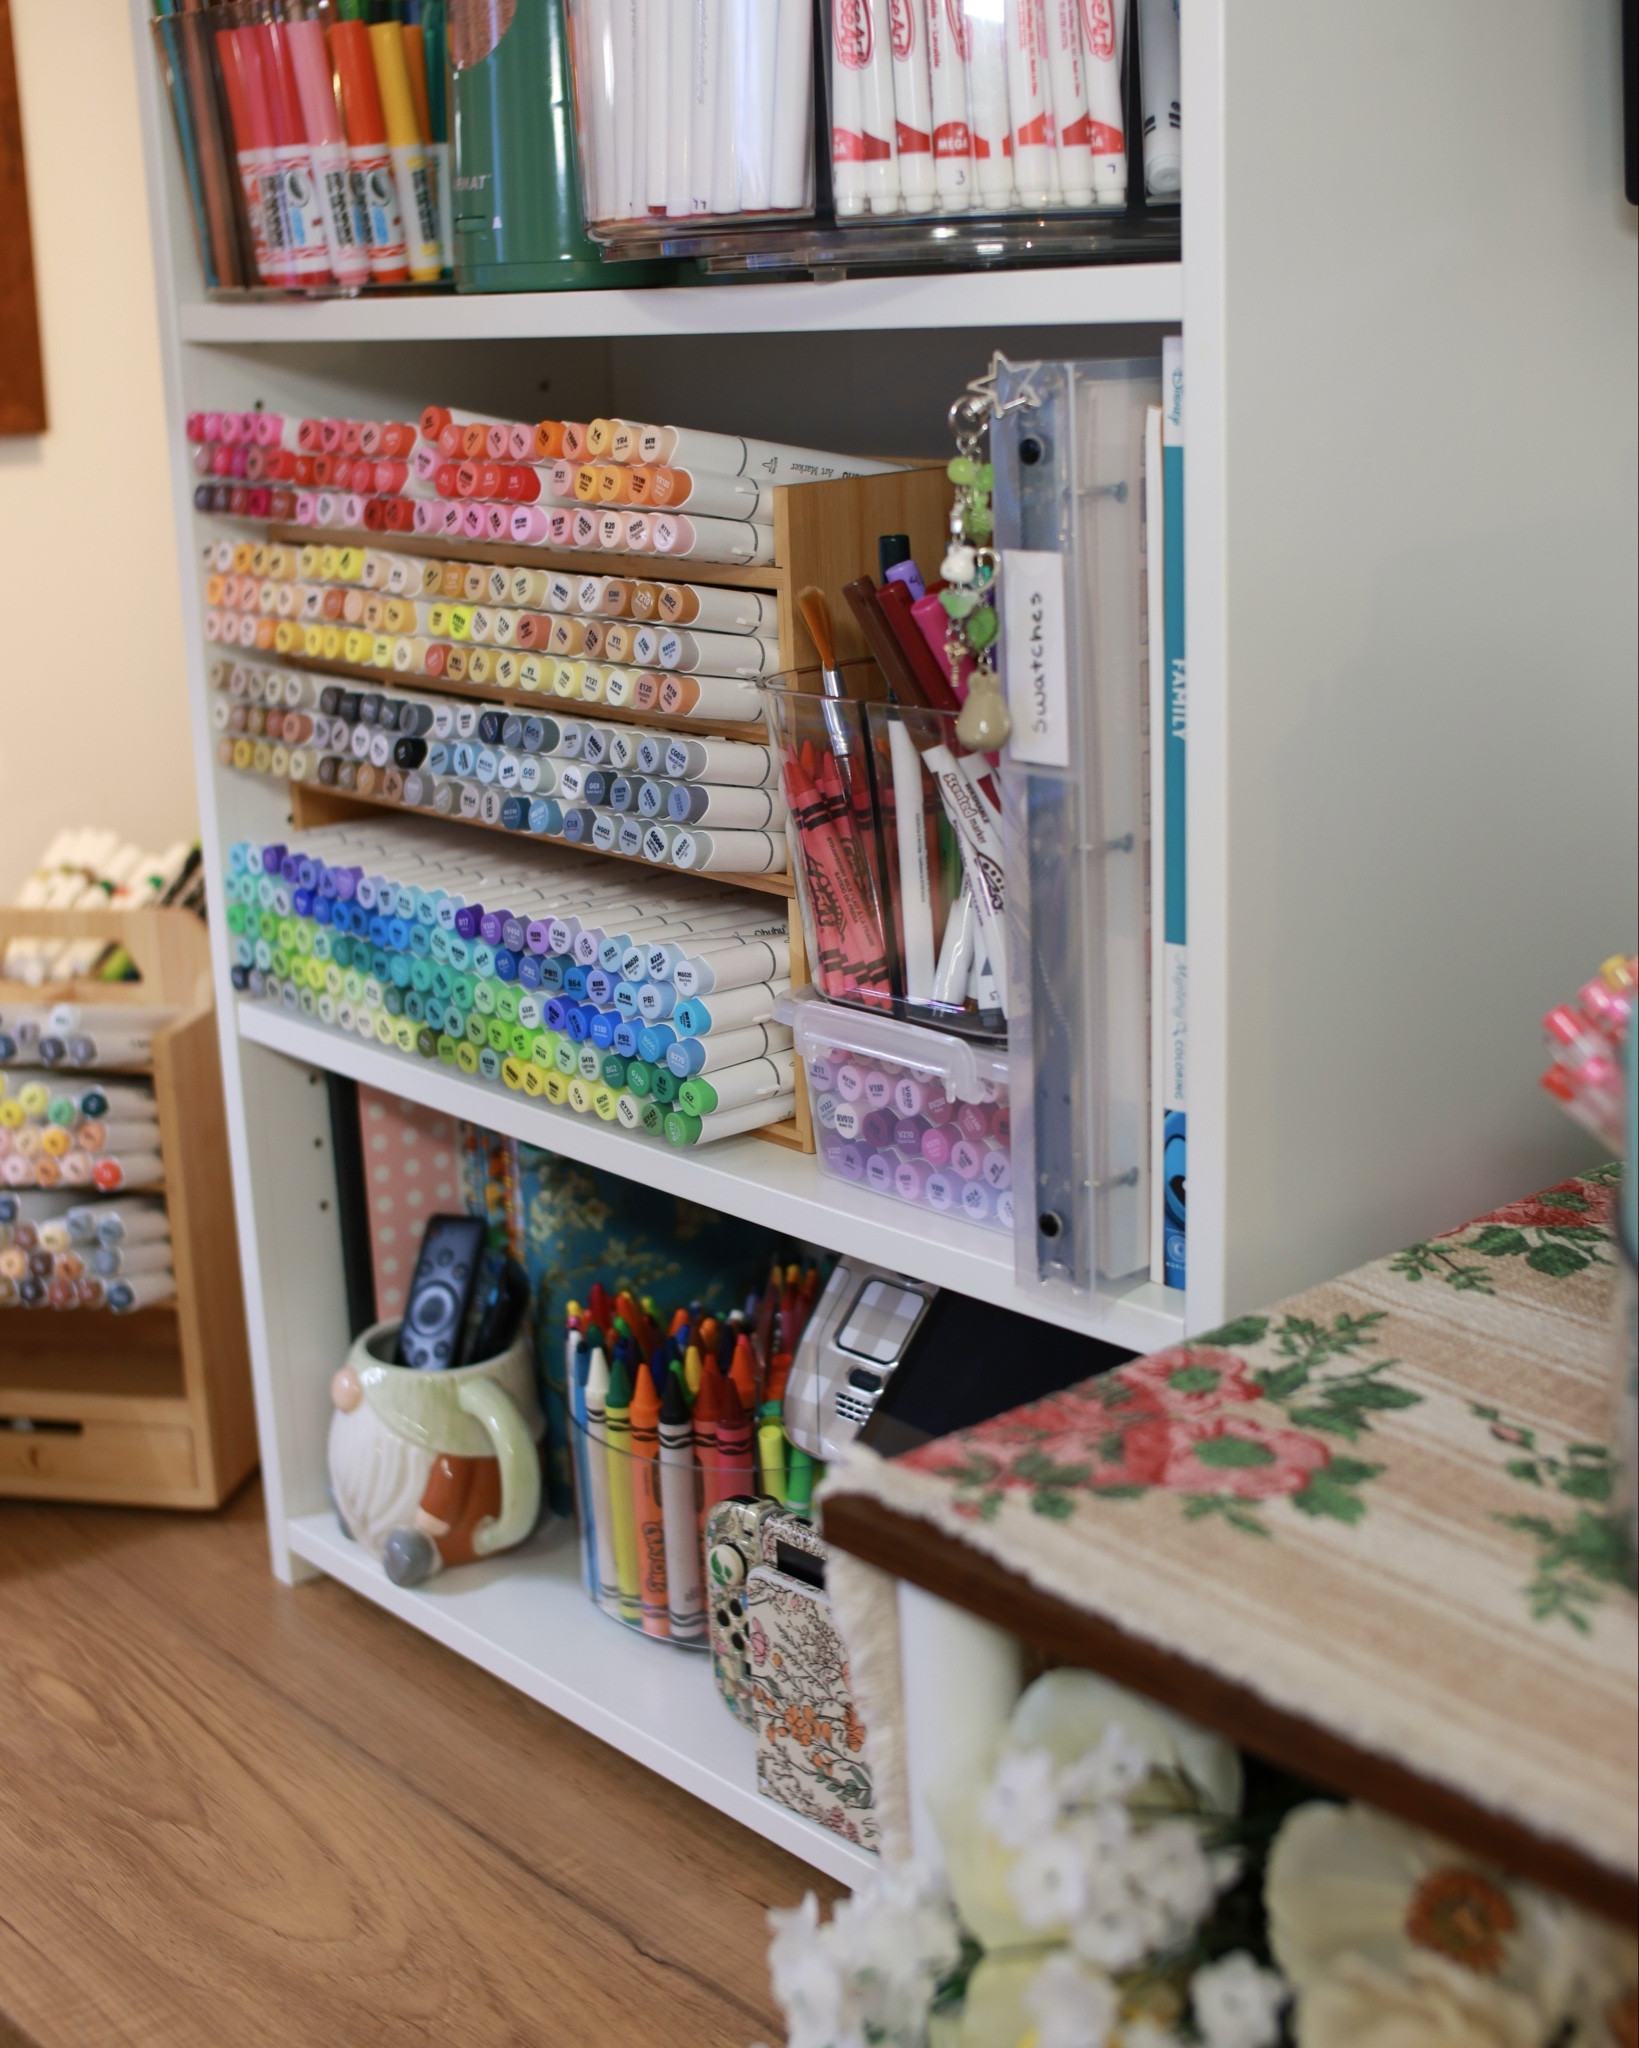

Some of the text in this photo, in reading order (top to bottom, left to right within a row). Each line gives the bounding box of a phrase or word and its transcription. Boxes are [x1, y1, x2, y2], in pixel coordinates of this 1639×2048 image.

[1172, 658, 1186, 741] FAMILY
[965, 783, 990, 824] WASHABLE
[969, 818, 987, 844] marker
